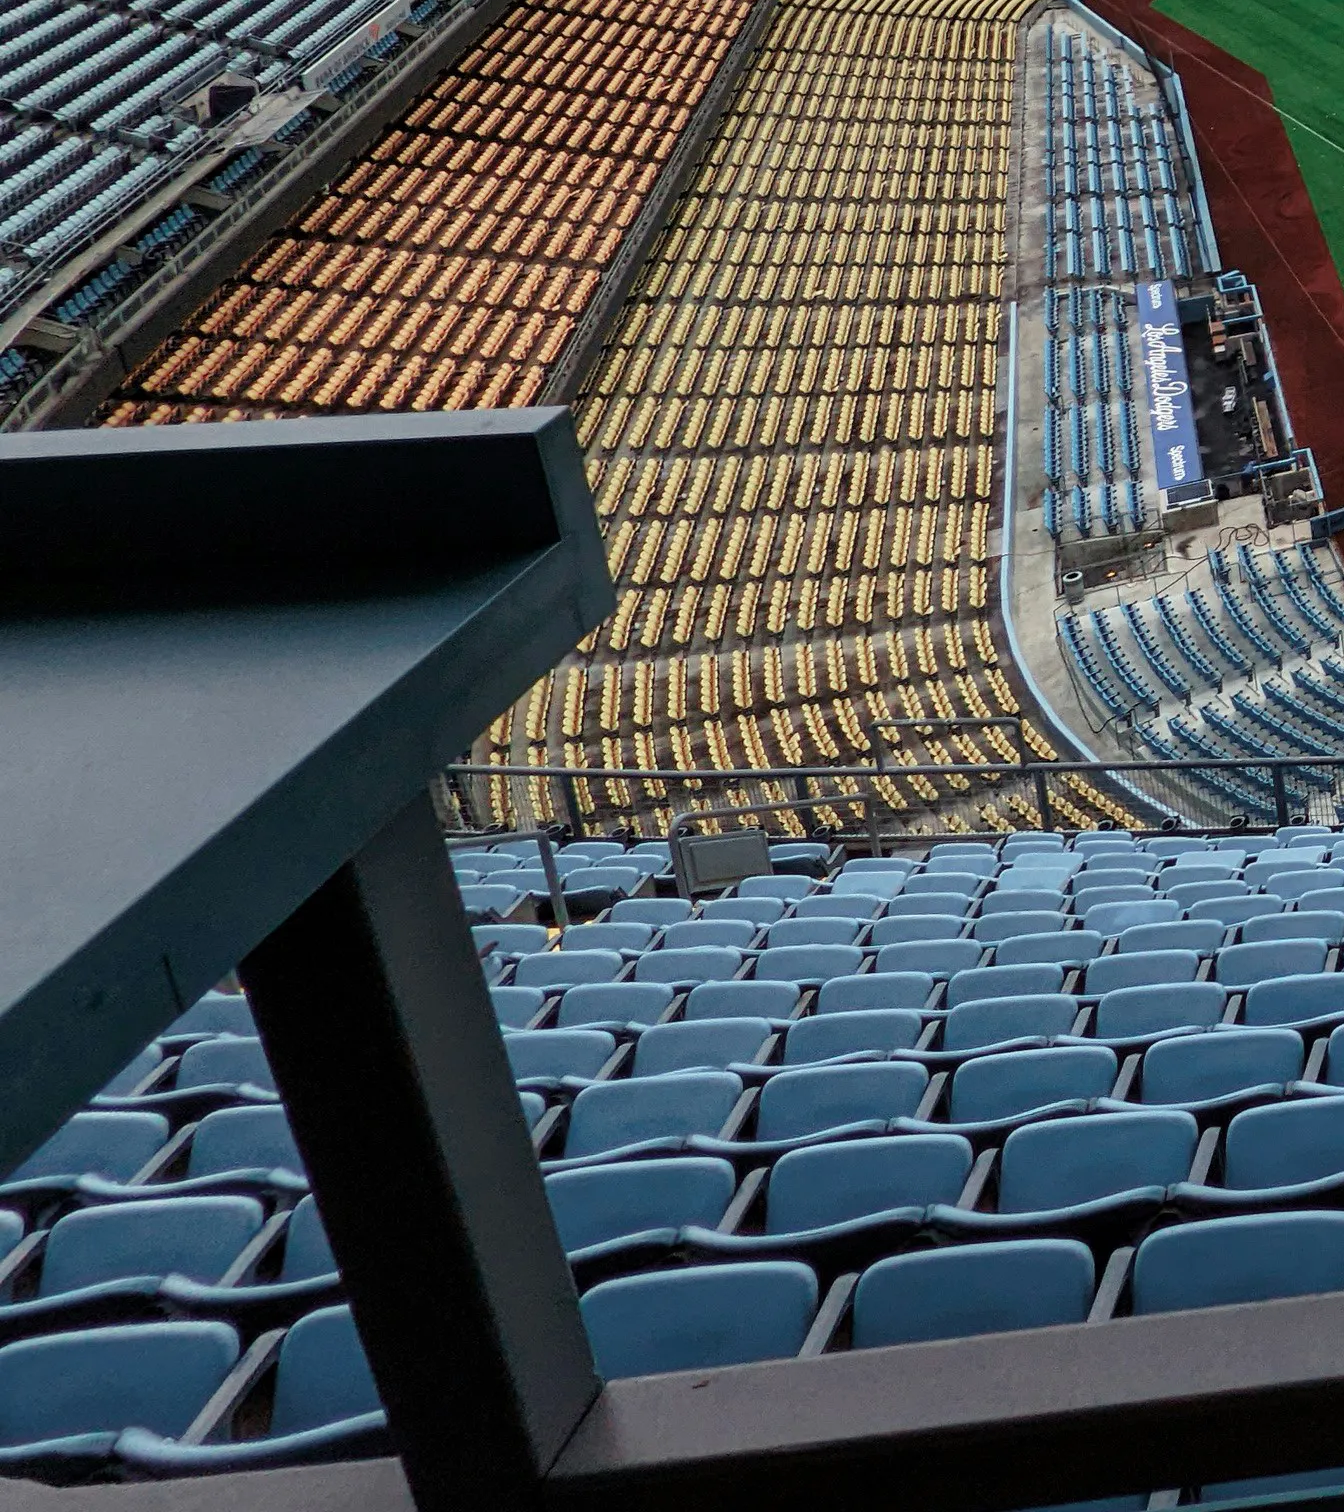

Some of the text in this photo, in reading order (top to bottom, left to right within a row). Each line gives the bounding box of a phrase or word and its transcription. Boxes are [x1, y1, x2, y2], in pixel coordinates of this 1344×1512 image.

[1145, 345, 1182, 388] Angeles
[1151, 381, 1188, 431] Dodgers
[1167, 444, 1186, 481] Spectrum
